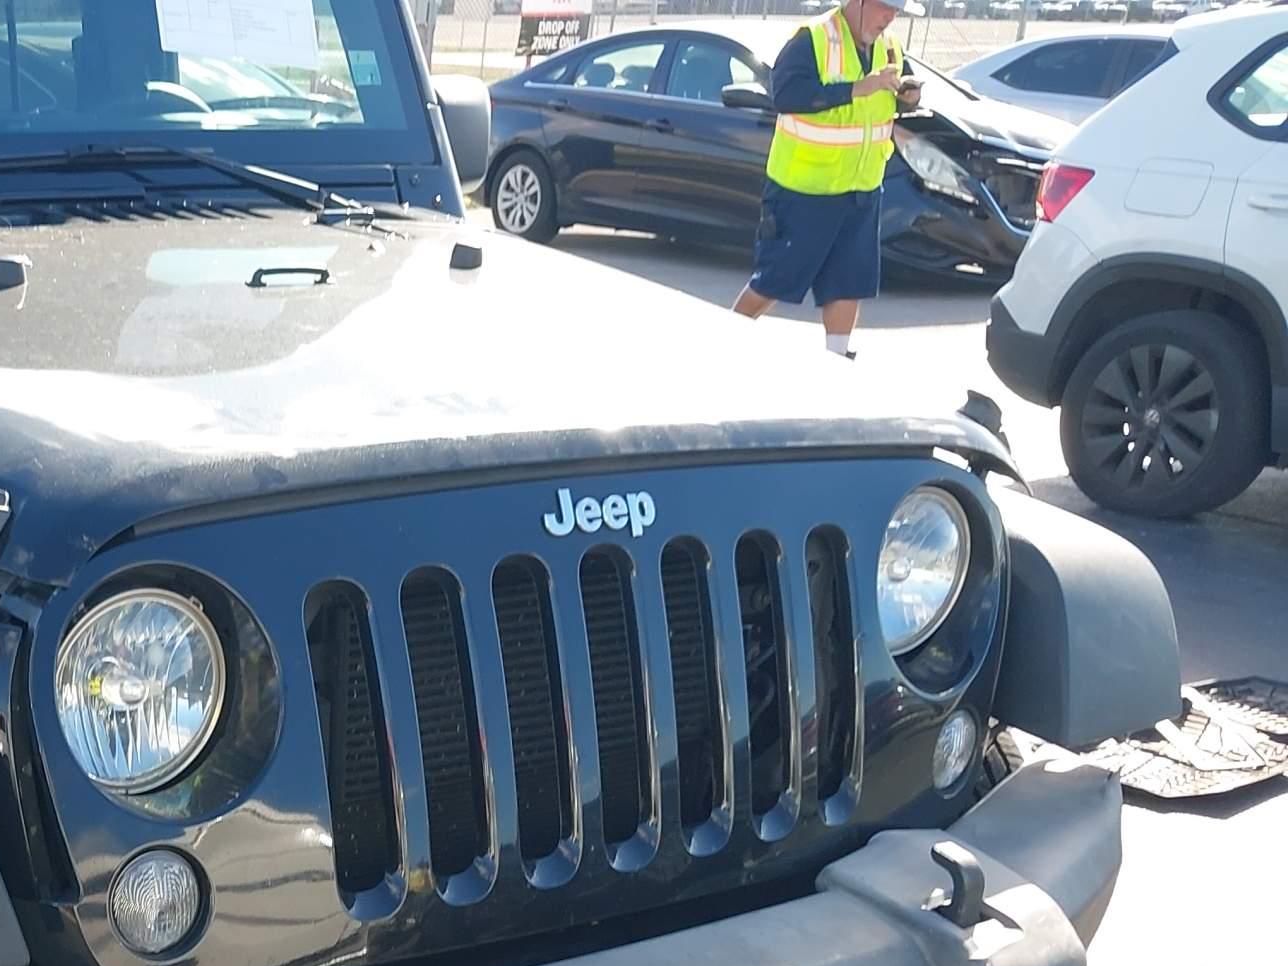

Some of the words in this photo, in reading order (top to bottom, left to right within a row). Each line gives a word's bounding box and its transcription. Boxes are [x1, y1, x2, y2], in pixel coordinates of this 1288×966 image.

[537, 20, 565, 35] DROP
[565, 20, 581, 35] OFF
[531, 35, 558, 50] ZONE
[558, 35, 581, 50] ONLY
[543, 487, 657, 538] Jeep
